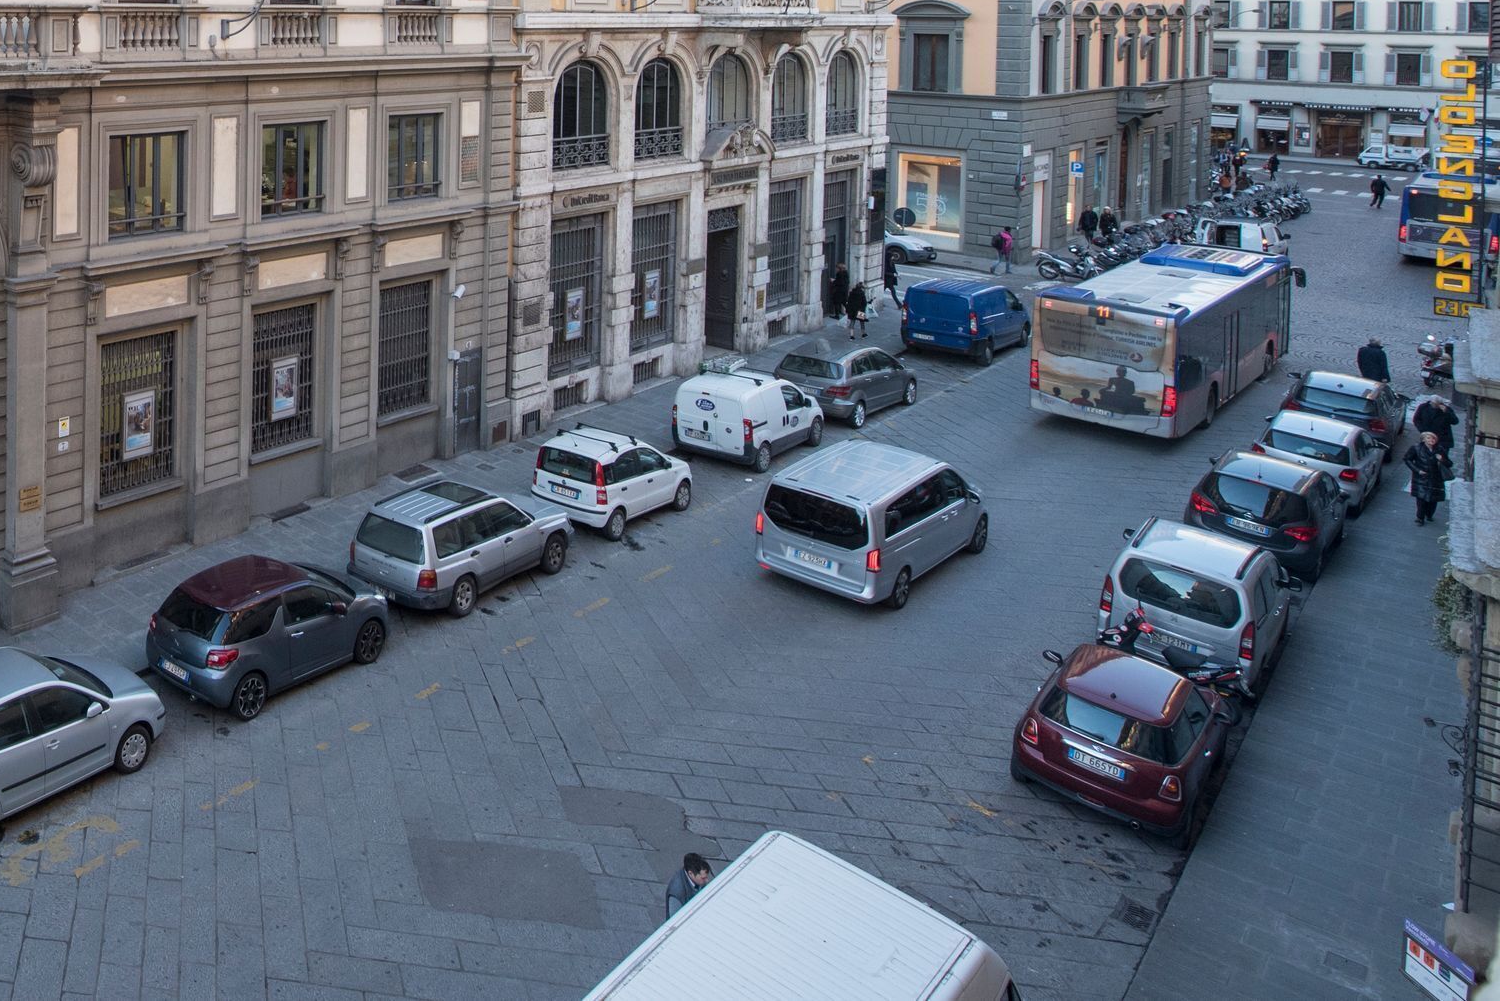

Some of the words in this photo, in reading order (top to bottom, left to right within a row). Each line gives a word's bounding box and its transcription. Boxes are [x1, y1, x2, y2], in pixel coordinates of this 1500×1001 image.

[1073, 163, 1081, 171] P
[1097, 305, 1110, 318] 11
[1075, 751, 1086, 762] DT
[1090, 758, 1119, 775] 665YD
